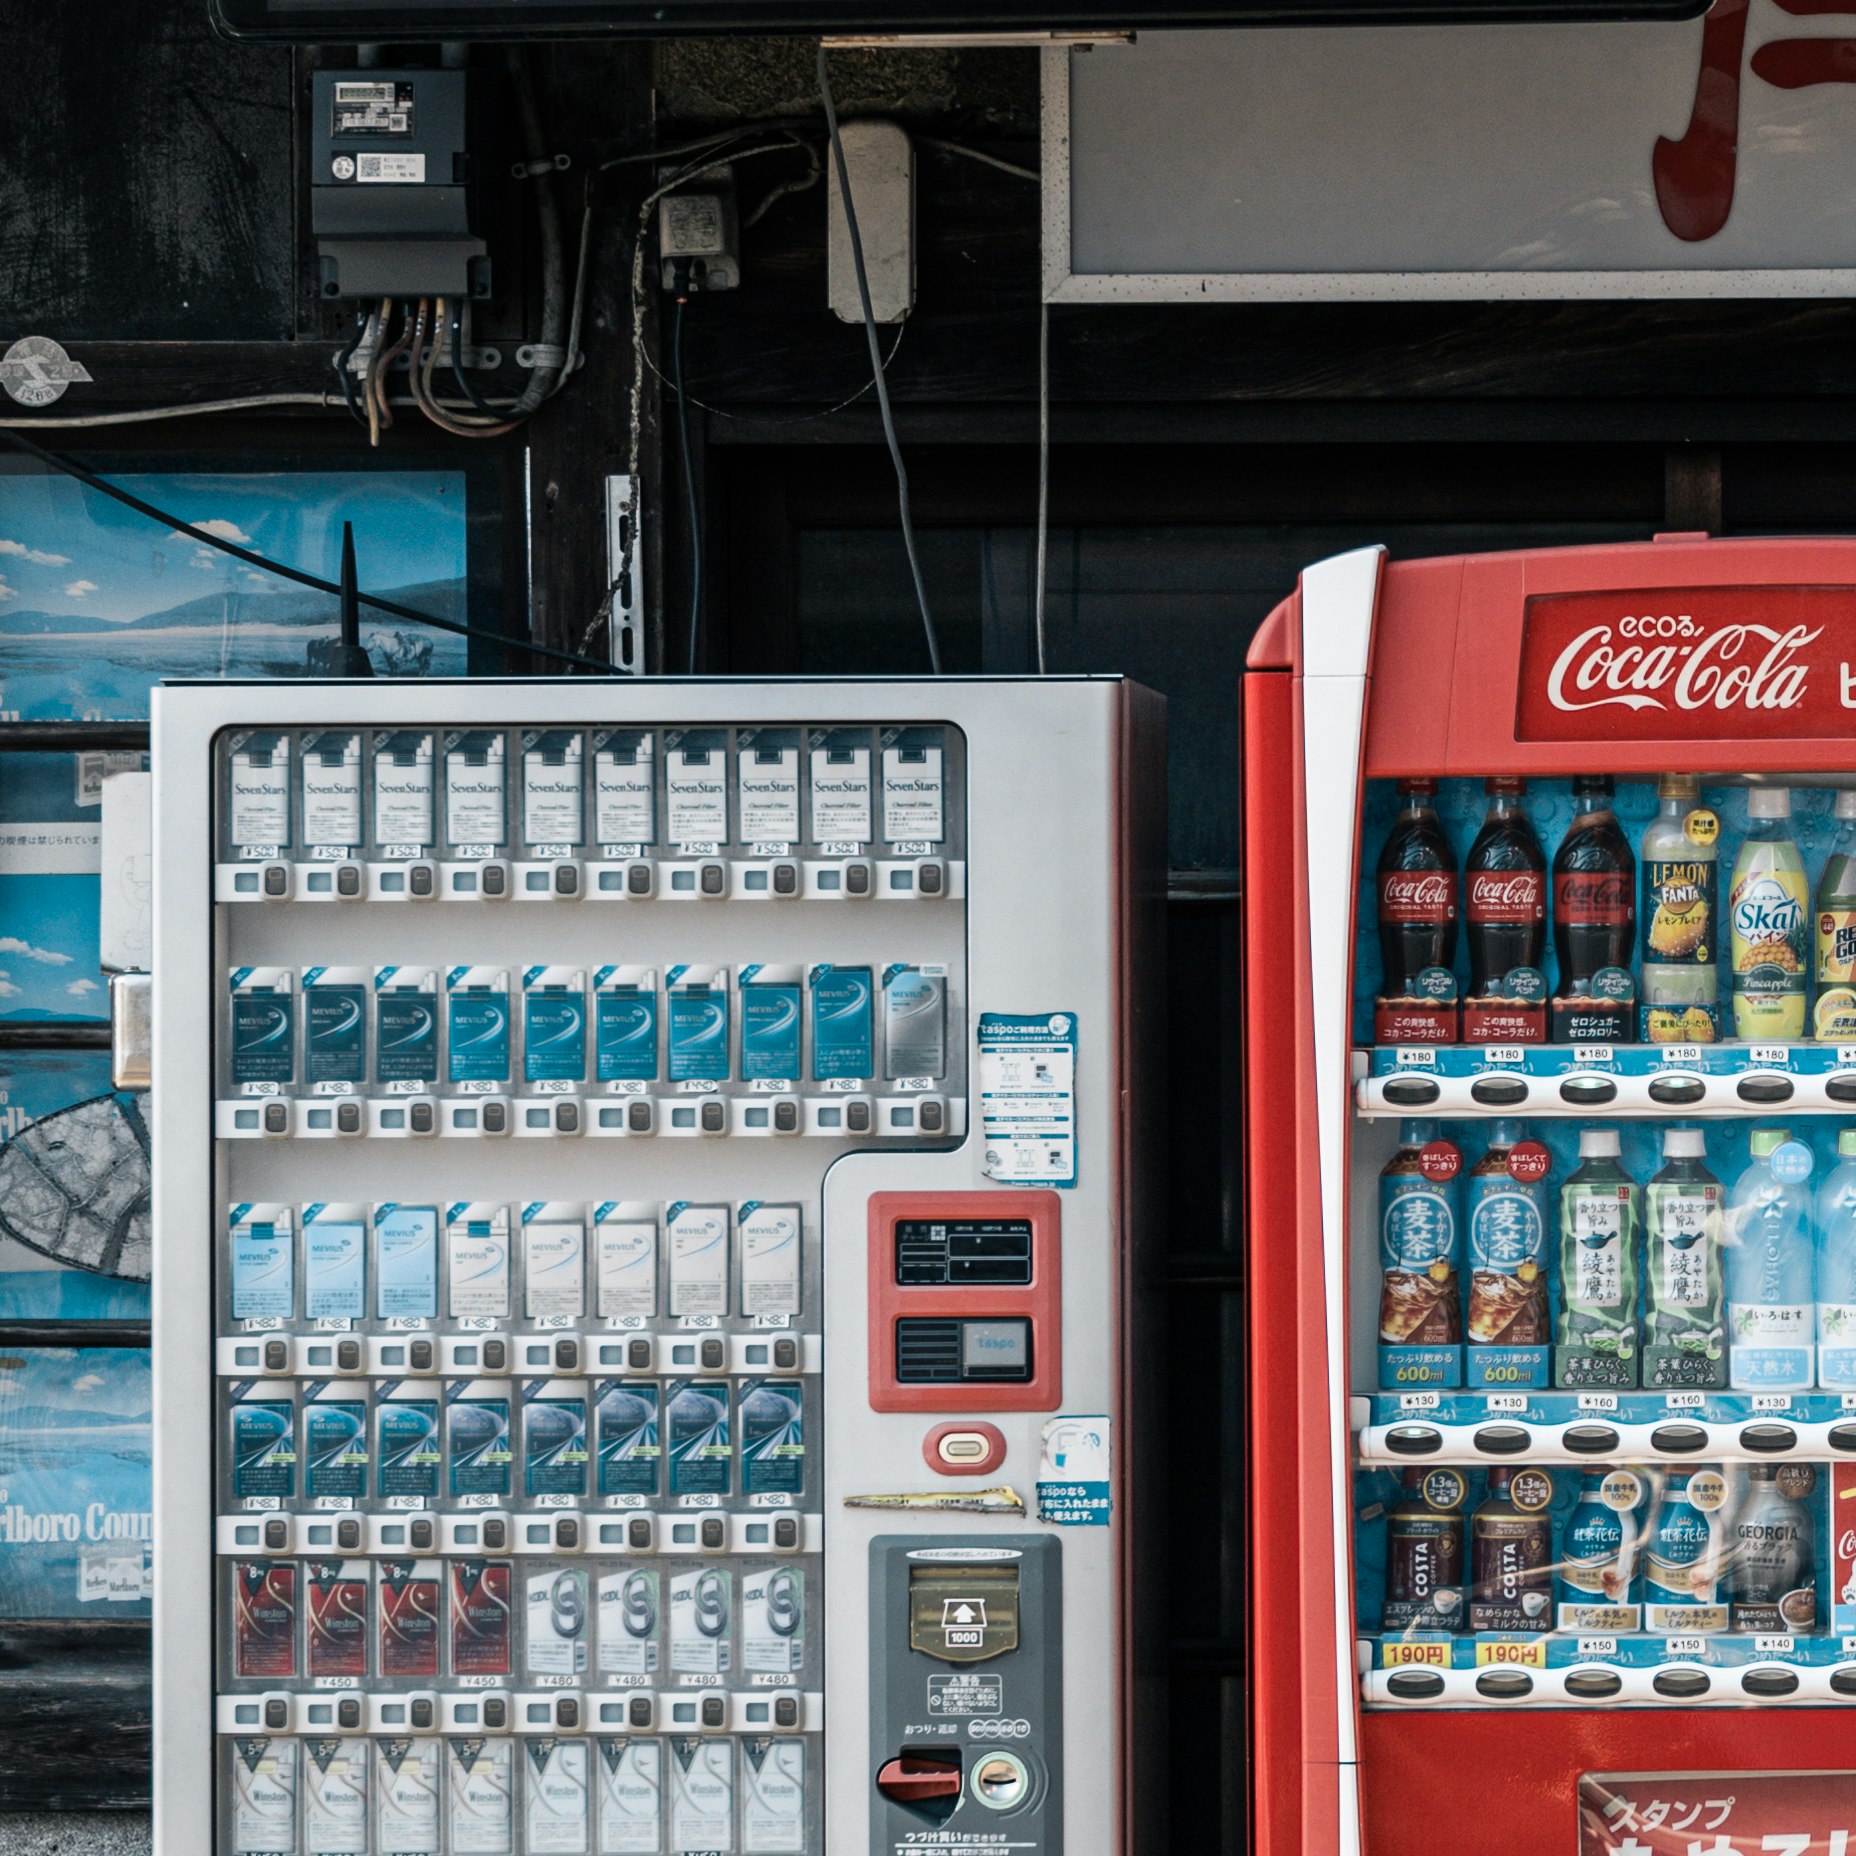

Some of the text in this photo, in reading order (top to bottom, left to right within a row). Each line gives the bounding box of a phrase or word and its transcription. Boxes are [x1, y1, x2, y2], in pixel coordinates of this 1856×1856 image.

[1546, 623, 1825, 711] Coca-Cola
[1653, 864, 1707, 888] LEMON
[1384, 877, 1448, 904] Coca-Cola
[1472, 877, 1537, 904] Coca-Cola
[1662, 886, 1699, 904] FANTA
[1570, 1017, 1621, 1027] ゼロシュガー
[1403, 1199, 1434, 1255] 麦茶
[1582, 1252, 1604, 1302] 綾鷹
[1386, 1353, 1453, 1365] たっぷり飲める
[1746, 1360, 1796, 1375] 天然水
[1396, 1366, 1443, 1382] 600ml
[1562, 1371, 1630, 1385] 香り立つ旨み
[1737, 1524, 1800, 1541] GEORGIA
[1415, 1542, 1428, 1596] COSTA
[951, 1633, 977, 1642] 1000
[1390, 1646, 1444, 1665] 190円
[1609, 1796, 1736, 1831] スタンプ
